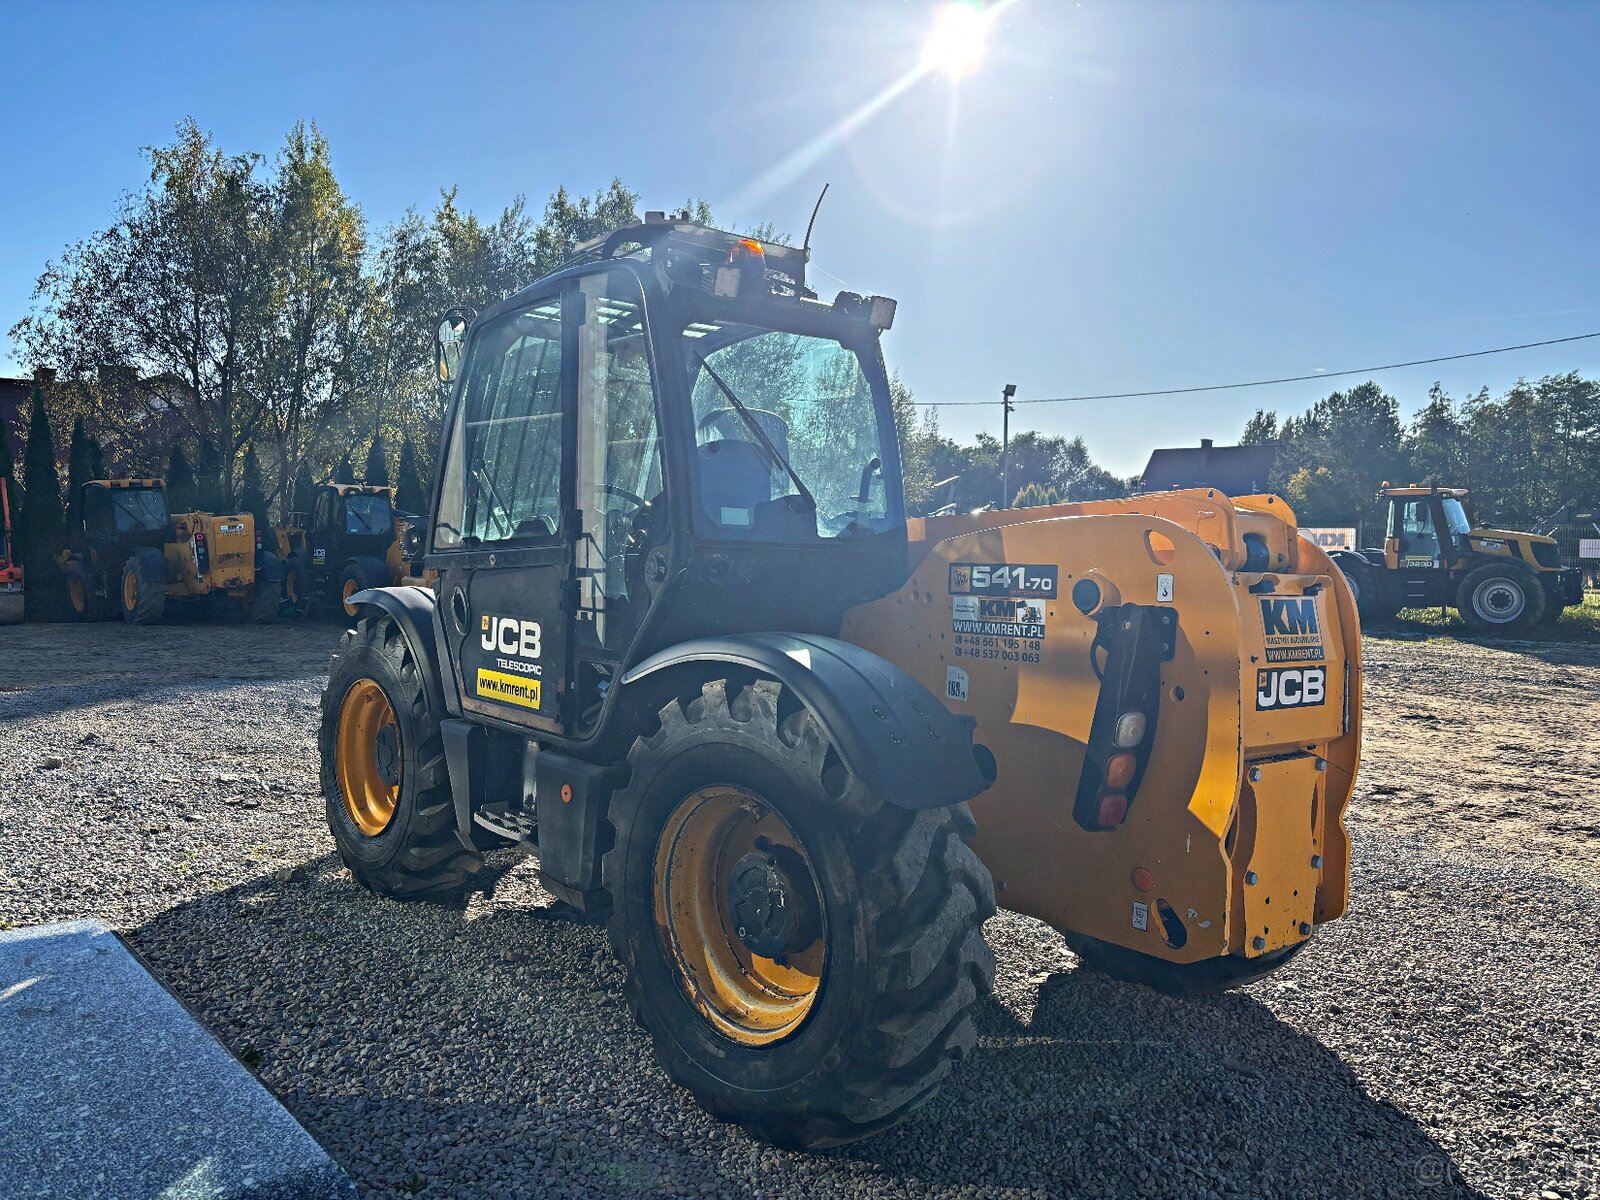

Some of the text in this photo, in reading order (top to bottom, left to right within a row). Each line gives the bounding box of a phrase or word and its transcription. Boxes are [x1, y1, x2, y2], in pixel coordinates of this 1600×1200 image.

[972, 566, 1052, 591] 541-70
[980, 600, 1016, 617] KM
[1260, 599, 1318, 635] KM
[481, 616, 541, 658] JCB
[953, 620, 1044, 638] WWW.KMRENT.PL
[964, 637, 1040, 651] +48 661 195 148
[964, 648, 1040, 663] +48 537 003 063
[496, 658, 542, 675] TELESCOPIC
[479, 677, 538, 703] www.kmrent.pl
[1258, 669, 1324, 707] JCB
